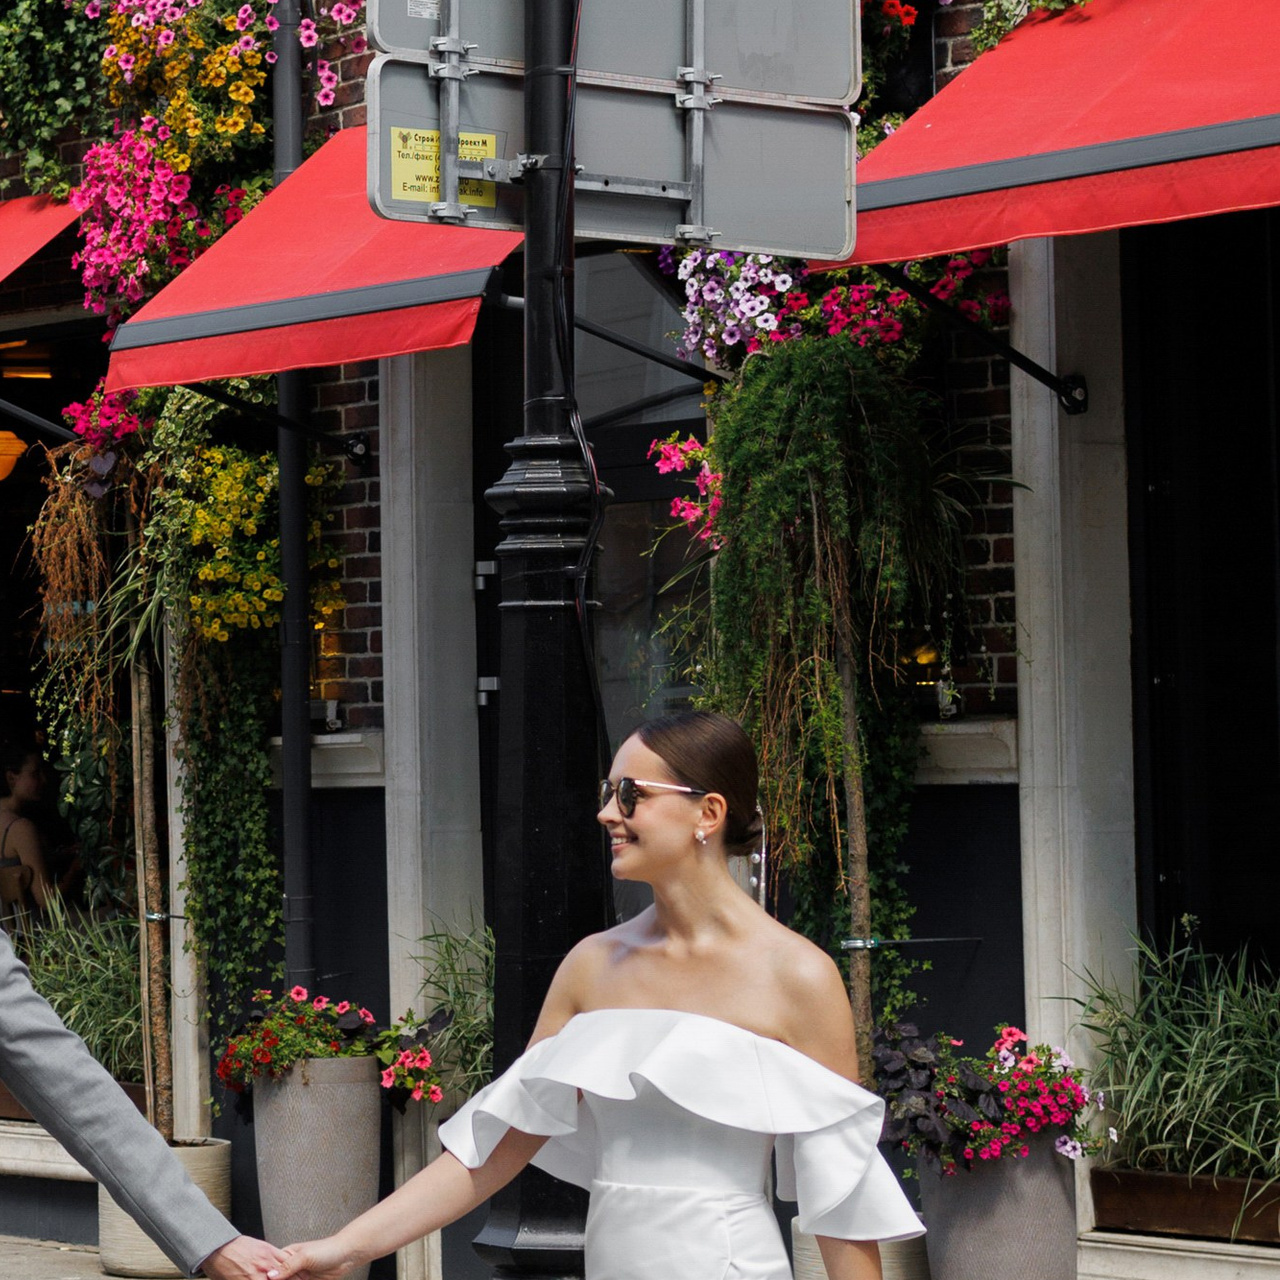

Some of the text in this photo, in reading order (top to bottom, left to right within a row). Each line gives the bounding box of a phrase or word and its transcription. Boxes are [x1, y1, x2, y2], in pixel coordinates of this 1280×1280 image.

[414, 133, 434, 144] Строй
[397, 150, 433, 161] Тел./факс
[402, 181, 428, 192] E-mail:
